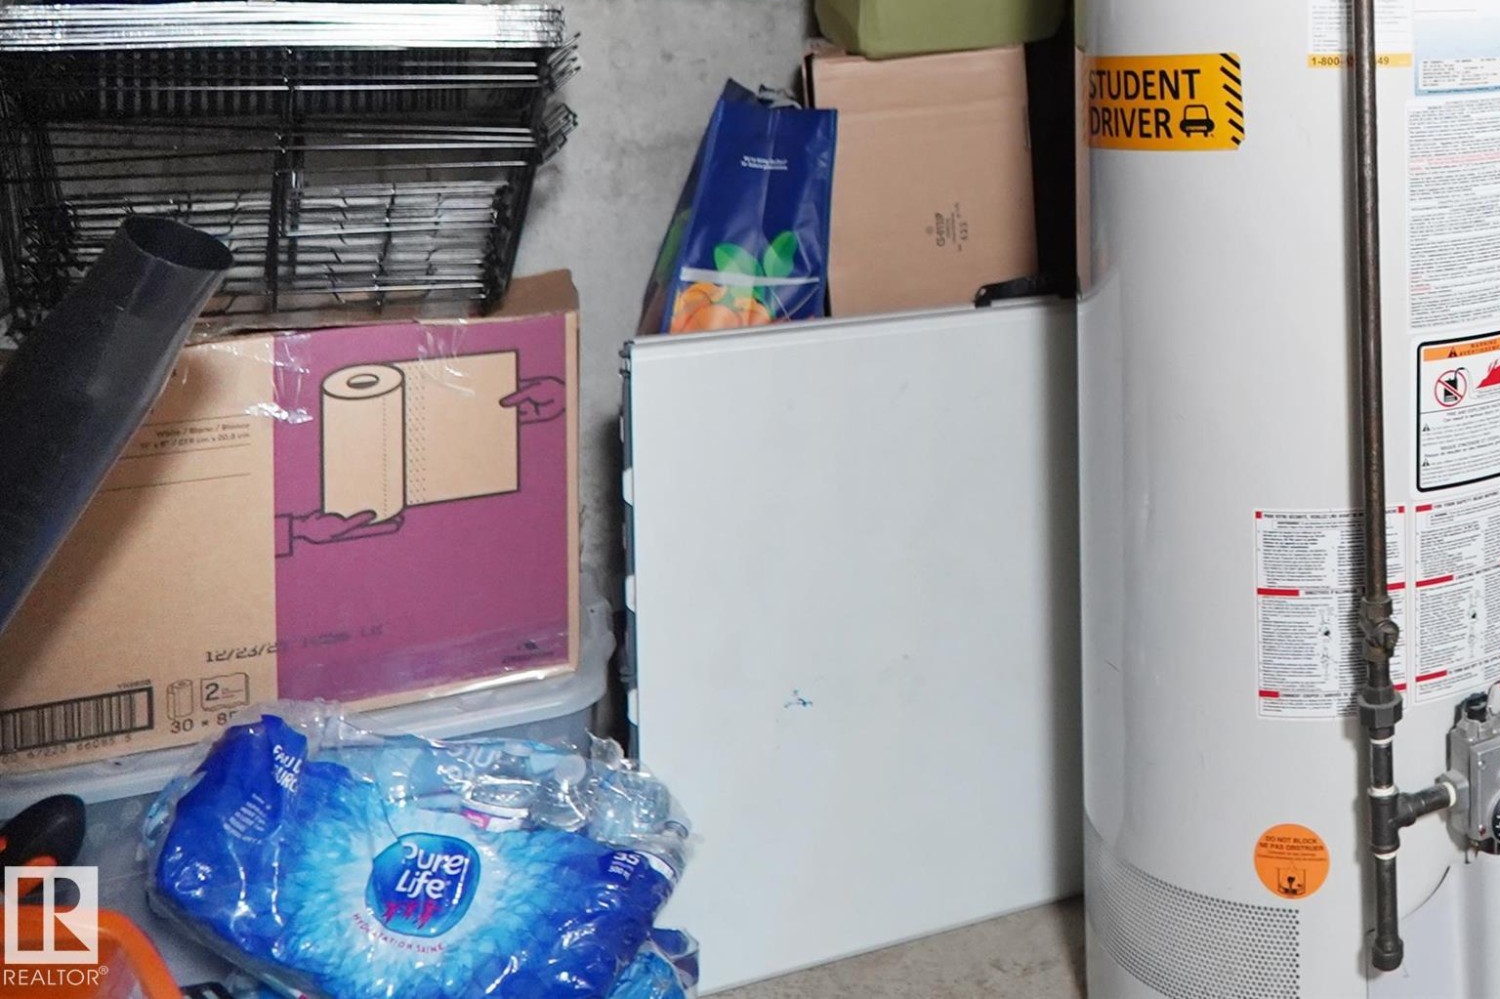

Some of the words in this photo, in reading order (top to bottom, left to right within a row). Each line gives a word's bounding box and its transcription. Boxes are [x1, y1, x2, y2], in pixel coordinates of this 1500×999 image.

[1089, 69, 1201, 100] STUDENT
[1089, 106, 1173, 138] DRIVER
[205, 682, 219, 701] 2
[171, 718, 194, 734] 30
[401, 842, 465, 875] Pure
[395, 869, 446, 899] Life
